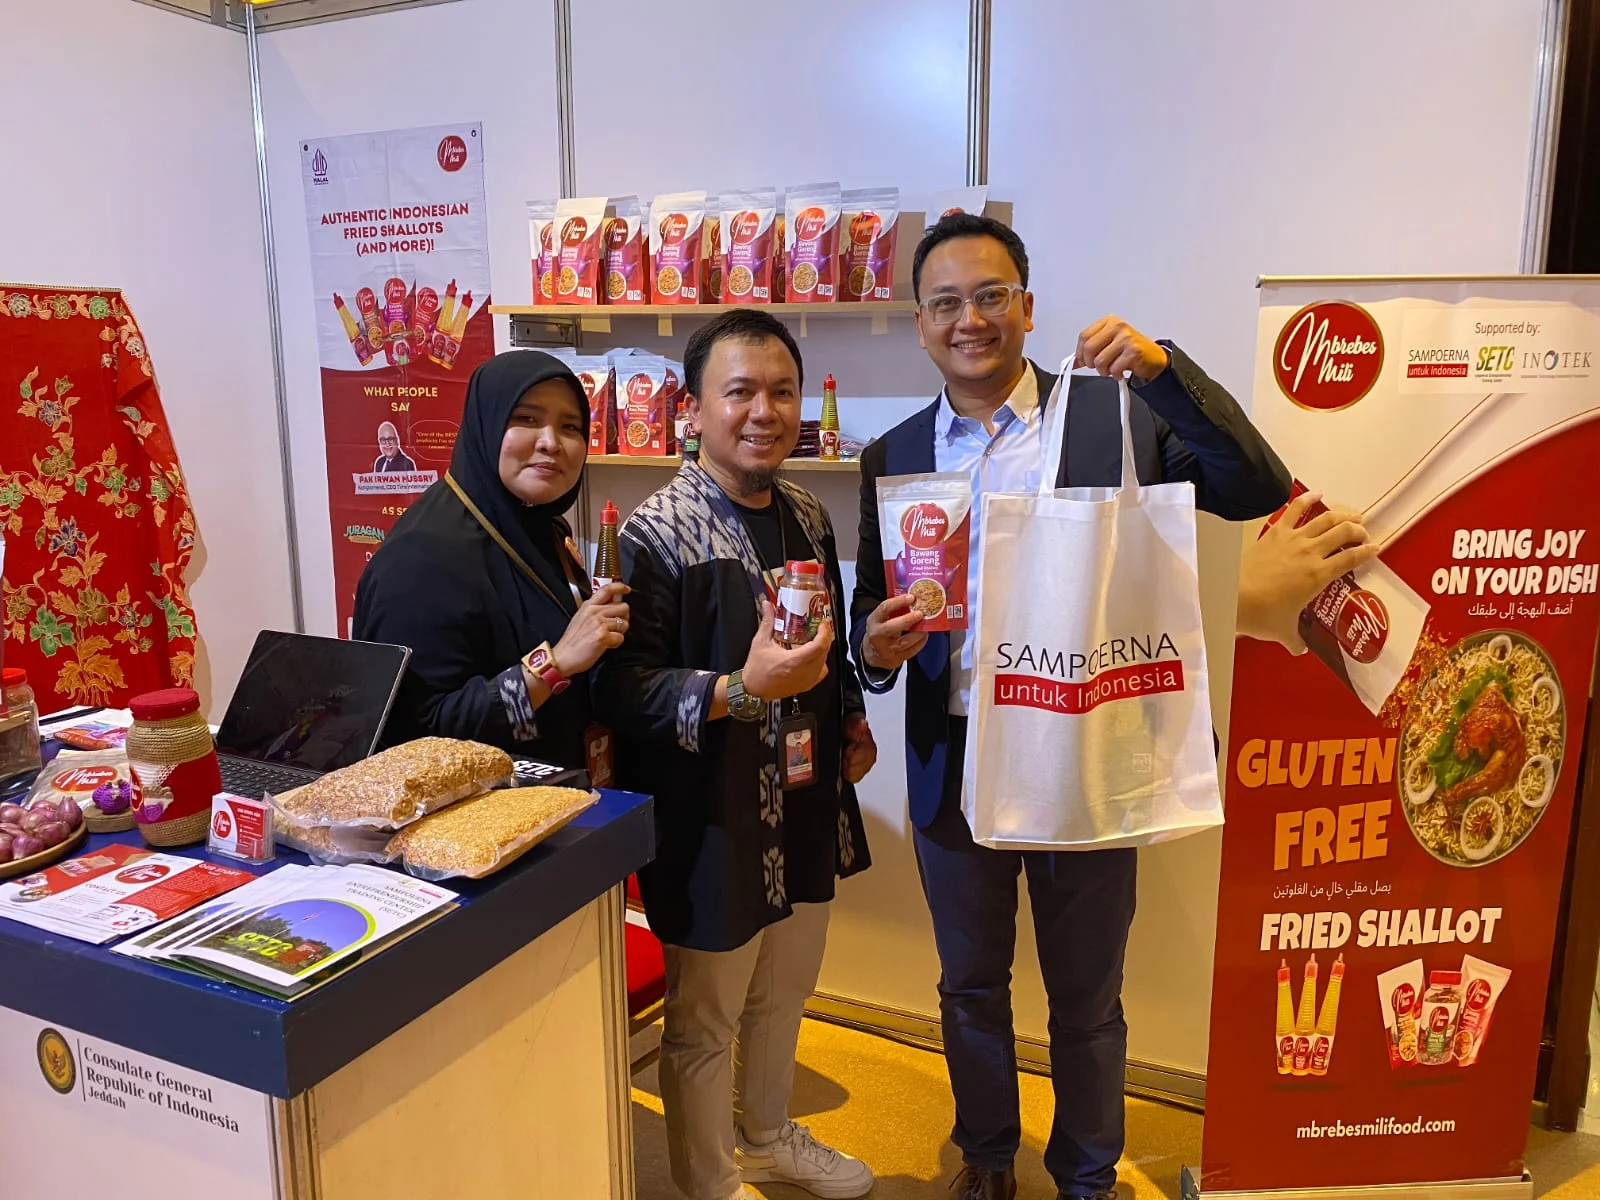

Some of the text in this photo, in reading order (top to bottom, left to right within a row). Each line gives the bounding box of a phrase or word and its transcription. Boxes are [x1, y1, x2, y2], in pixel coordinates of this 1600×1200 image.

[321, 203, 469, 225] AUTHENTIC INDONESIAN
[344, 222, 443, 239] FRIED SHALLOTS
[356, 239, 434, 257] (AND MORE)!
[1475, 322, 1541, 336] Supported by:
[1281, 312, 1377, 393] Mbrebes
[1408, 349, 1470, 362] SAMPOERNA
[1476, 346, 1515, 371] SETC
[1522, 350, 1592, 370] INOTEK
[1317, 357, 1354, 384] Mili
[1409, 366, 1430, 376] untuk
[1430, 364, 1467, 376] Indonesia
[364, 386, 438, 397] WHAT PEOPLE
[391, 402, 410, 412] SAY
[359, 475, 373, 484] PAK
[374, 475, 401, 483] IRWAN
[382, 506, 395, 515] AS
[343, 525, 385, 541] JURAGAN
[910, 550, 940, 559] Bawang
[1452, 529, 1586, 560] BRING JOY
[910, 557, 940, 567] Goreng
[1431, 564, 1600, 596] ON YOUR DISH
[1467, 597, 1574, 620] أضف البهجة إلى طبقك
[996, 632, 1179, 679] SAMPOERNA
[1000, 667, 1177, 709] untuk Indonesia
[1236, 737, 1398, 789] GLUTEN
[1273, 799, 1392, 871] FREE
[1273, 882, 1308, 899] الغلوتين
[1310, 885, 1324, 898] من
[1345, 880, 1368, 899] مقلي
[1369, 880, 1392, 896] بصل
[1260, 907, 1502, 951] FRIED SHALLOT
[84, 1046, 213, 1103] Consulate General
[87, 1067, 240, 1133] Republic of Indonesia
[88, 1086, 127, 1109] Jeddah
[1297, 1116, 1456, 1138] mbrebesmilifood.com
